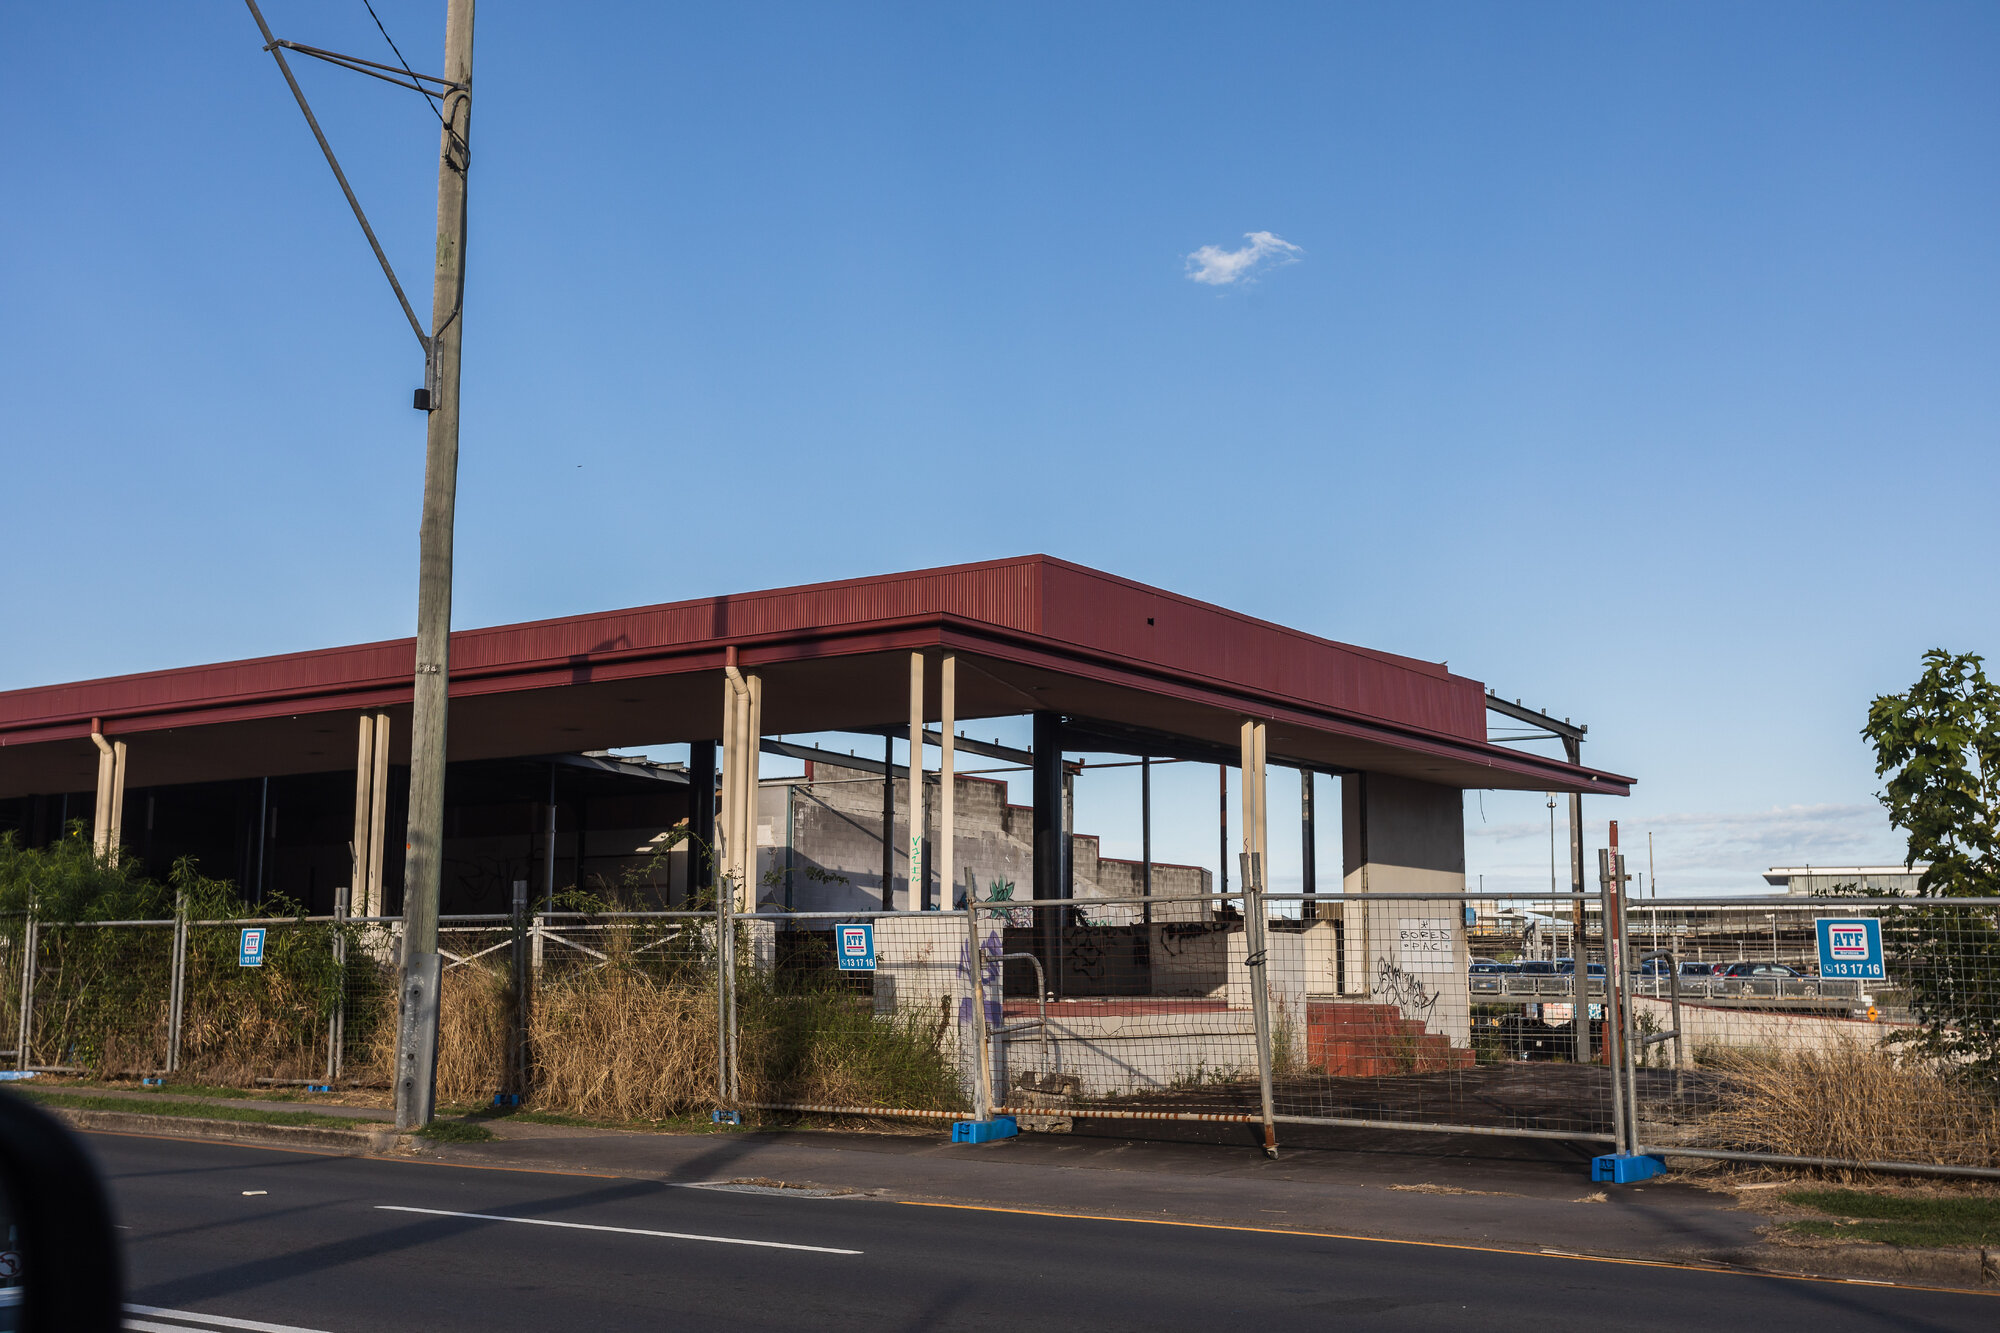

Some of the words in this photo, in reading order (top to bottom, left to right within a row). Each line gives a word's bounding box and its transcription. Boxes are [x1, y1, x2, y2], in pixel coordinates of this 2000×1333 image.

[846, 935, 864, 946] ATF
[1400, 930, 1450, 940] BORED
[1833, 932, 1864, 947] ATF
[846, 958, 855, 967] 13
[856, 958, 864, 967] 17
[865, 958, 874, 967] 16
[1834, 963, 1848, 975] 13
[1850, 963, 1864, 975] 17
[1866, 963, 1880, 975] 16
